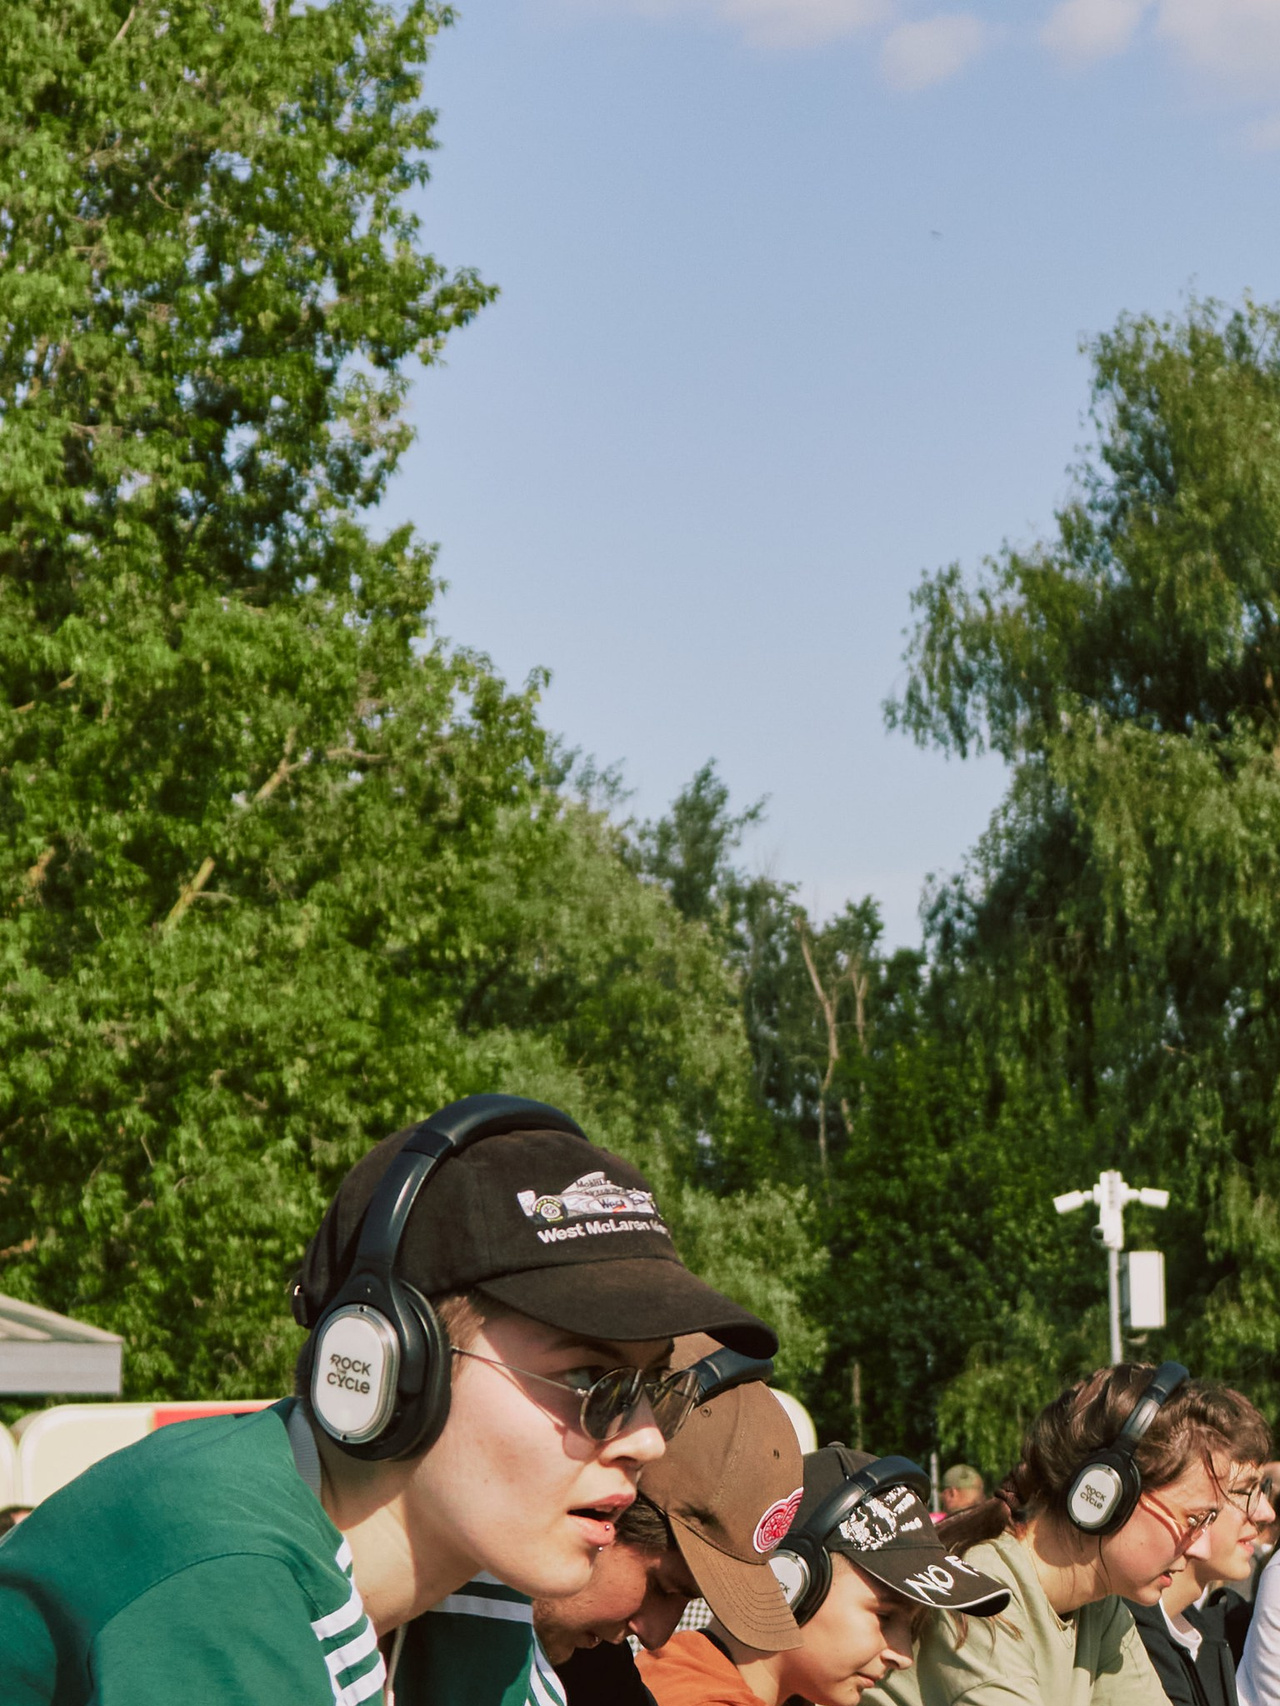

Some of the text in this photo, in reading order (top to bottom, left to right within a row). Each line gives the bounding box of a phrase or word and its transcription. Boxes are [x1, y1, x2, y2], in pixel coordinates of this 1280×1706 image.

[537, 1222, 586, 1244] West
[585, 1218, 651, 1235] McLaren
[330, 1353, 371, 1377] ROCK
[903, 1563, 955, 1605] NO
